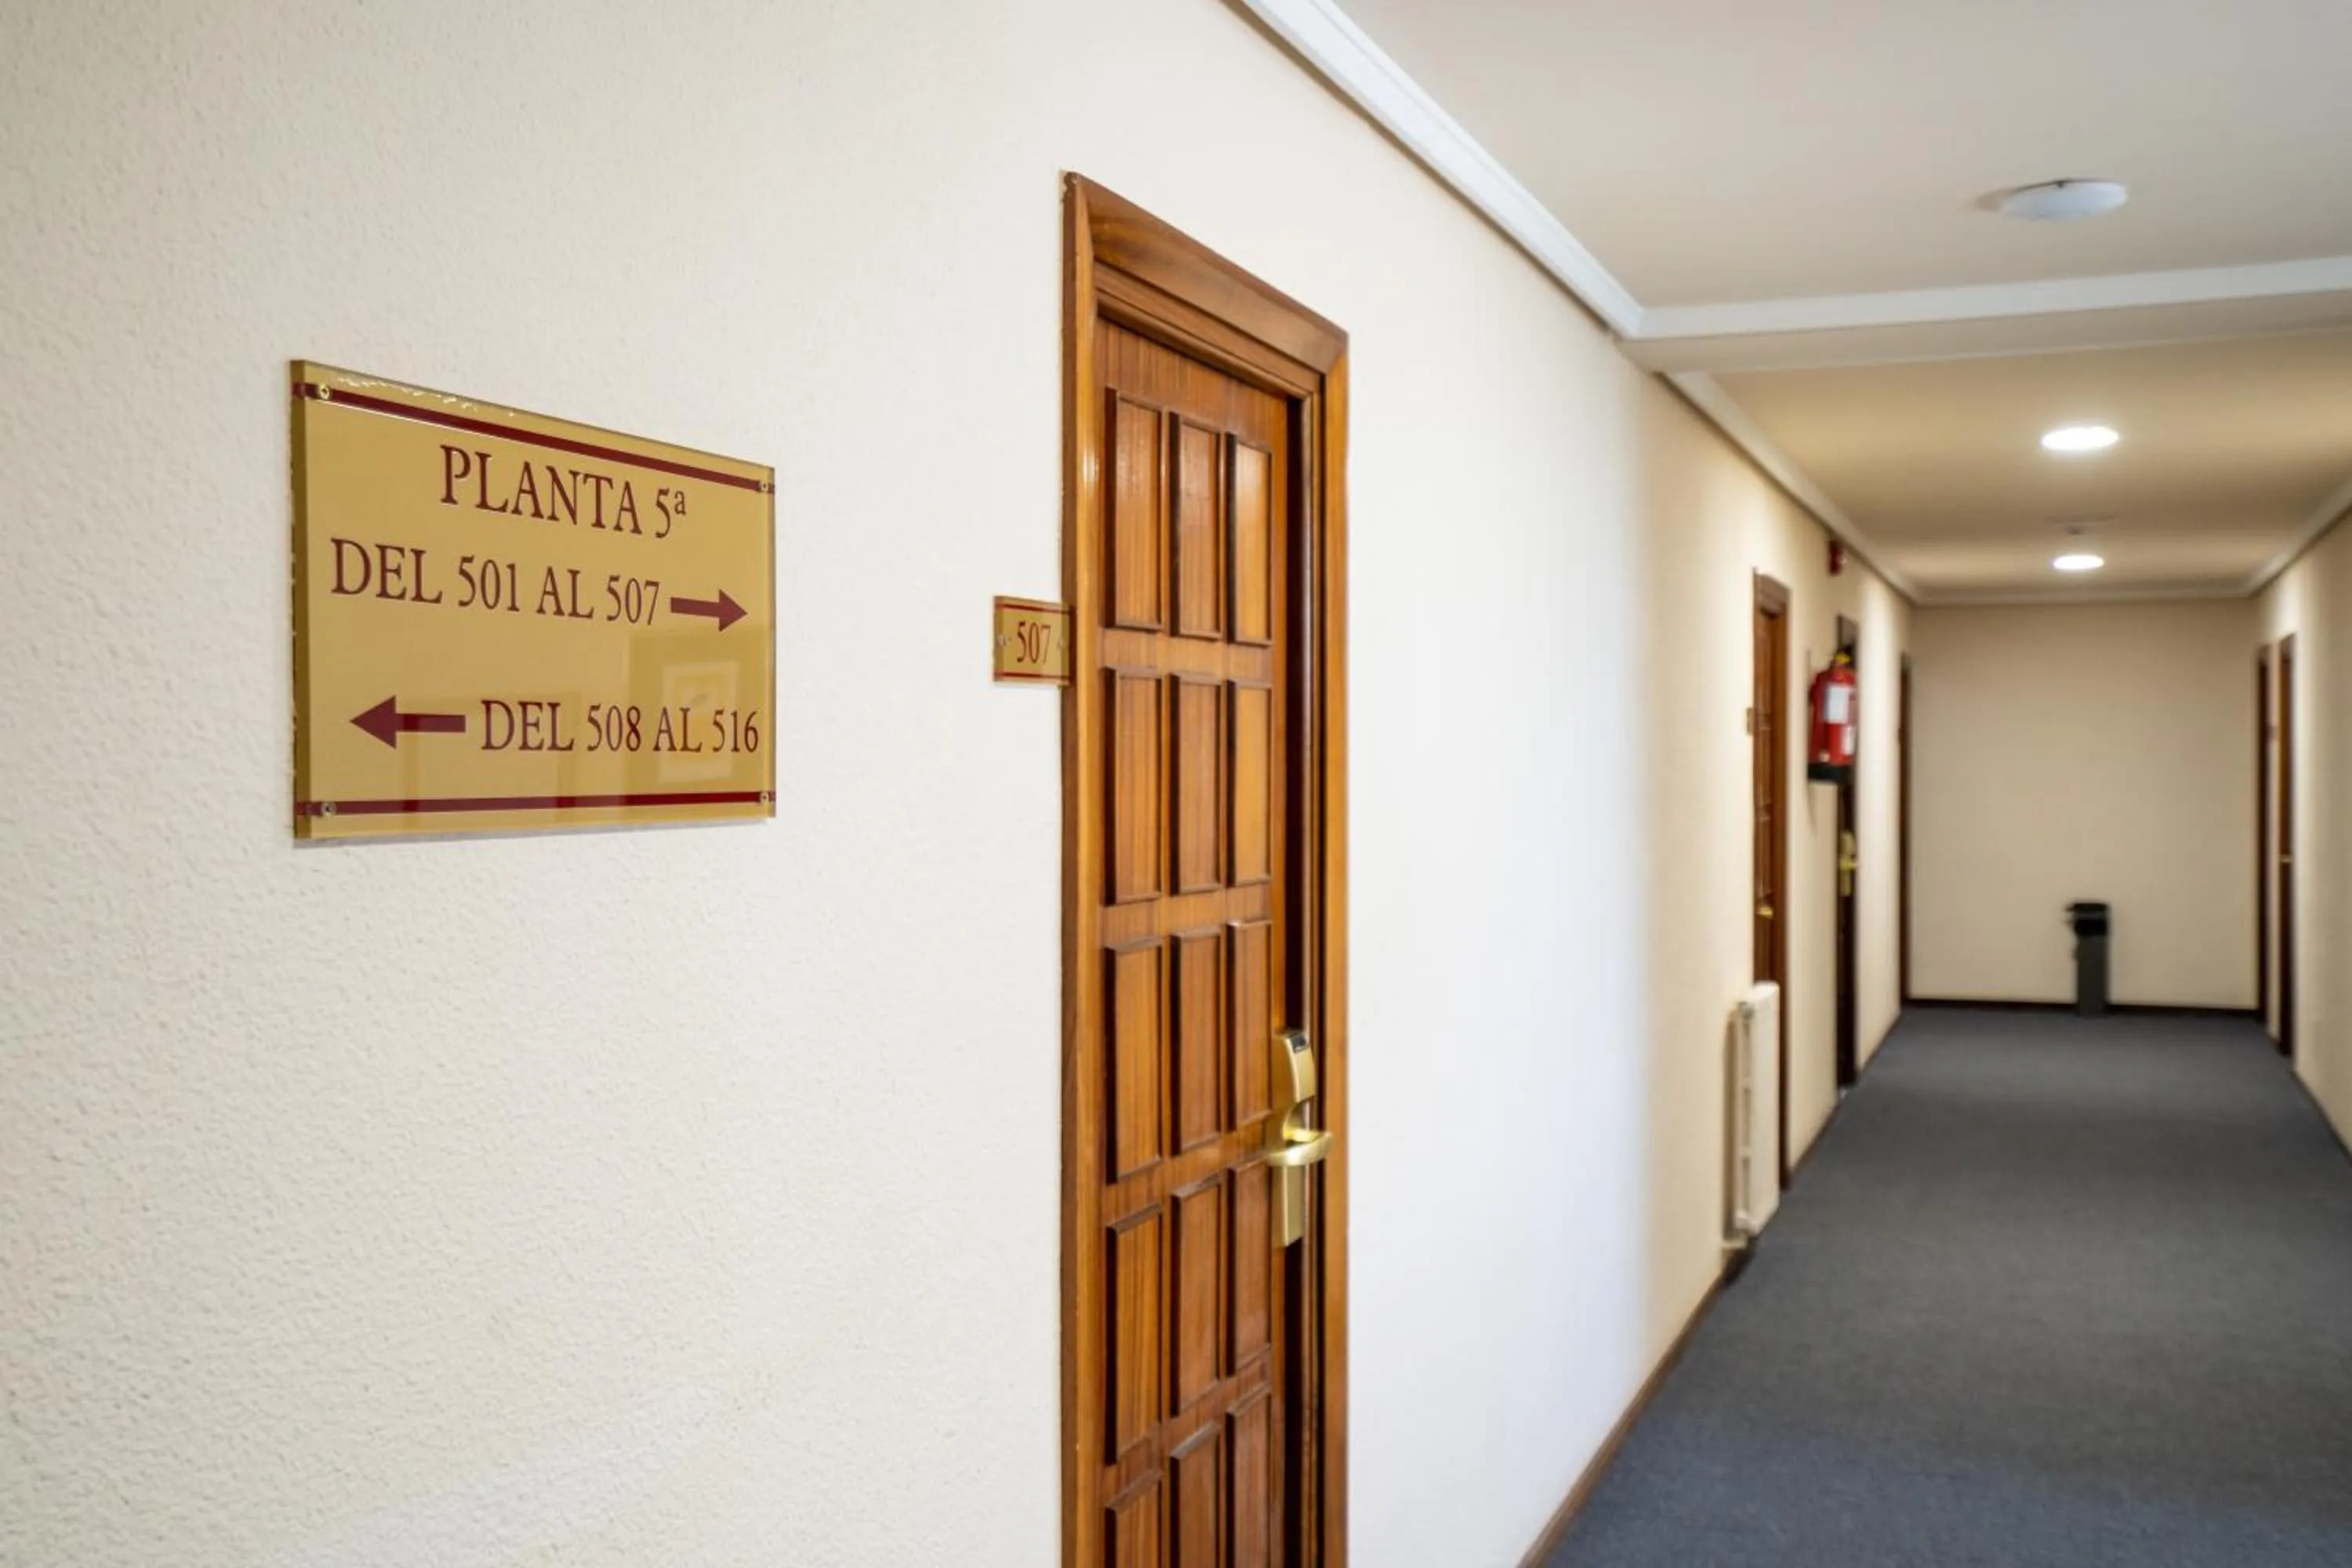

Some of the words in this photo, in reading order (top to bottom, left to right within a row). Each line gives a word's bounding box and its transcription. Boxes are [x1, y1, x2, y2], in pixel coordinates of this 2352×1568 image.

[439, 445, 643, 536] PLANTA
[330, 537, 443, 604] DEL
[457, 555, 521, 613] 501
[535, 564, 593, 620] AL
[606, 575, 660, 626] 507
[1017, 620, 1051, 665] 507
[481, 699, 575, 752] DEL
[586, 705, 643, 752] 508
[652, 706, 702, 753] AL
[712, 710, 760, 753] 516
